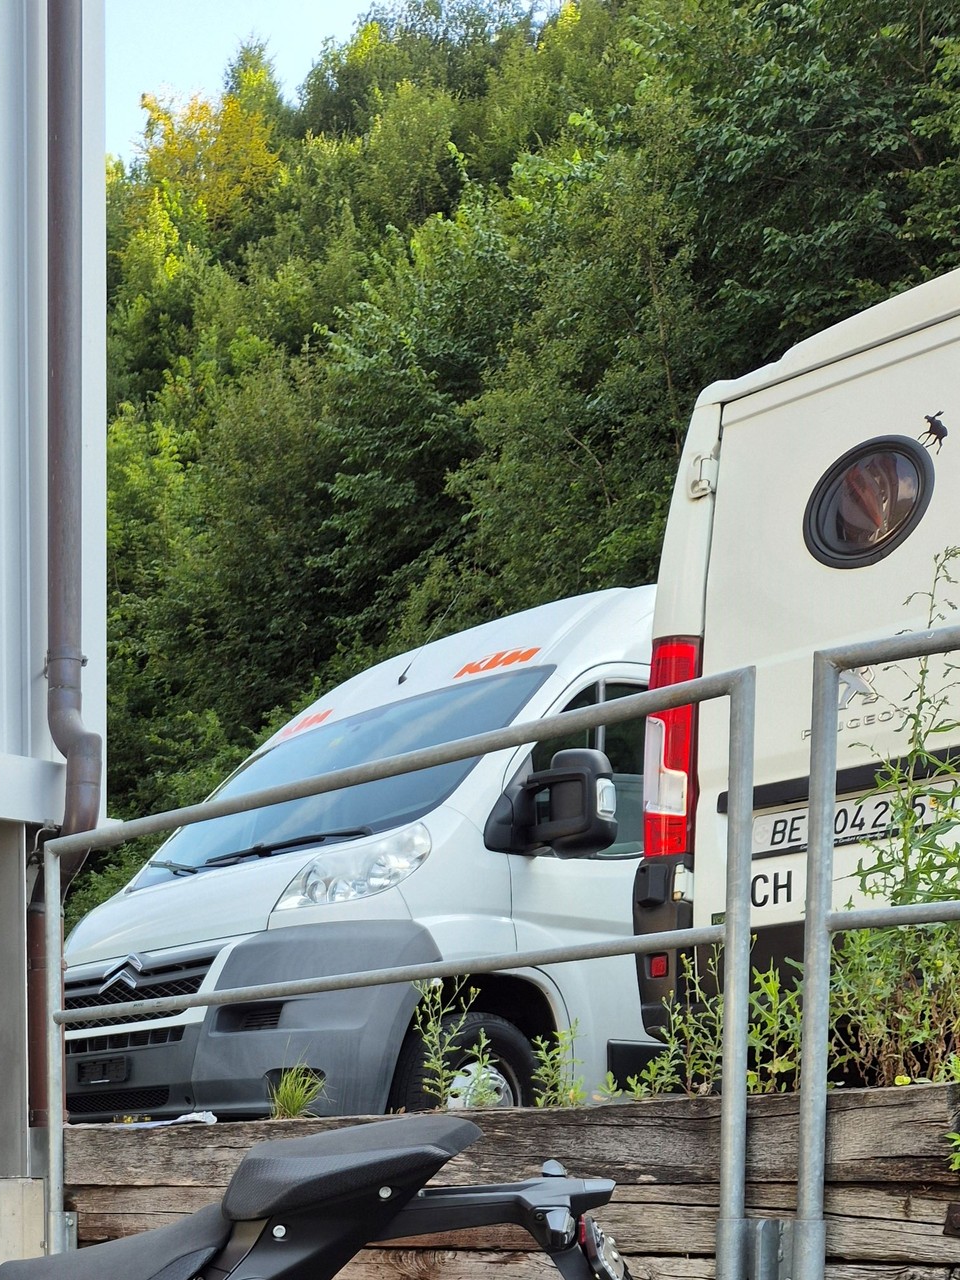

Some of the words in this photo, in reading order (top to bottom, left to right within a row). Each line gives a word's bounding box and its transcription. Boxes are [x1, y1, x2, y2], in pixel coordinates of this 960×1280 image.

[453, 646, 542, 679] KTM
[801, 706, 909, 740] PGEOT
[770, 815, 807, 846] BE
[871, 794, 926, 829] 25
[750, 870, 792, 908] CH
